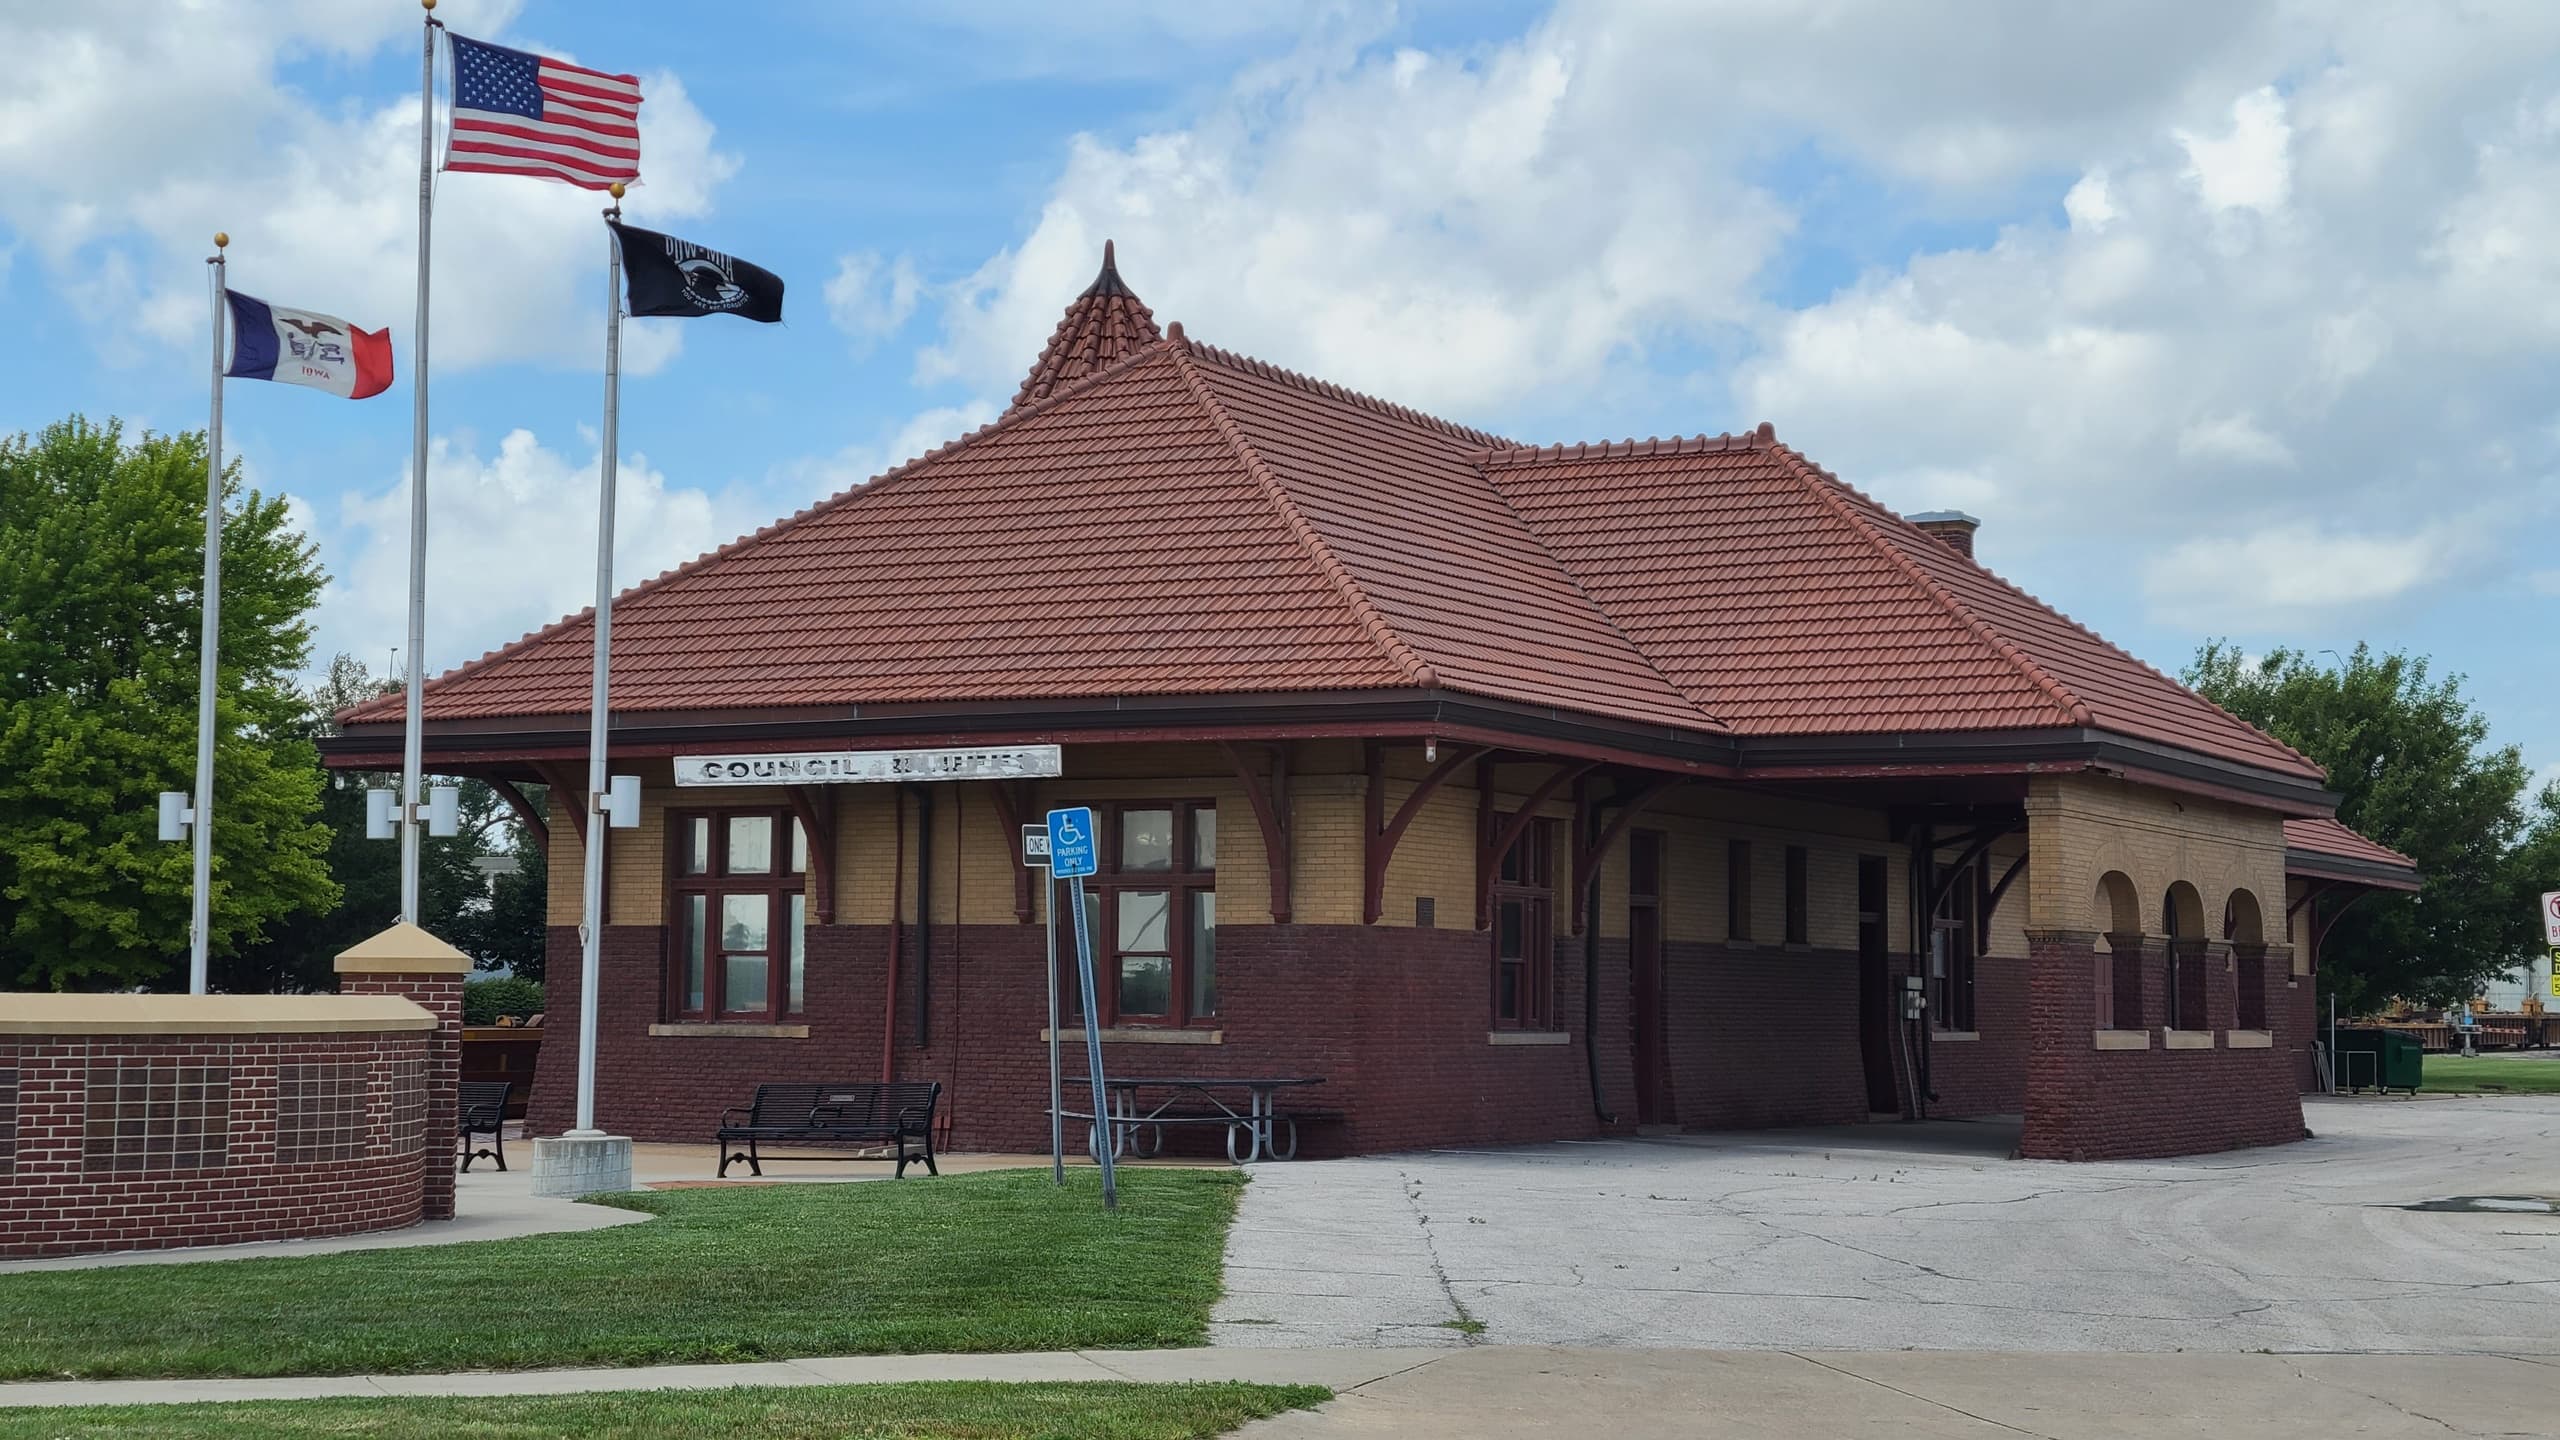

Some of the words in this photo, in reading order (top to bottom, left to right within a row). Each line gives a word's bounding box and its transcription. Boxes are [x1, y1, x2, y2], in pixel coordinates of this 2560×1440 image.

[706, 248, 734, 282] MIA
[302, 366, 329, 379] IOWA
[702, 759, 860, 778] COUNCIL
[1029, 838, 1044, 853] ONE
[1057, 846, 1088, 856] PARKING
[1064, 857, 1083, 867] ONLY
